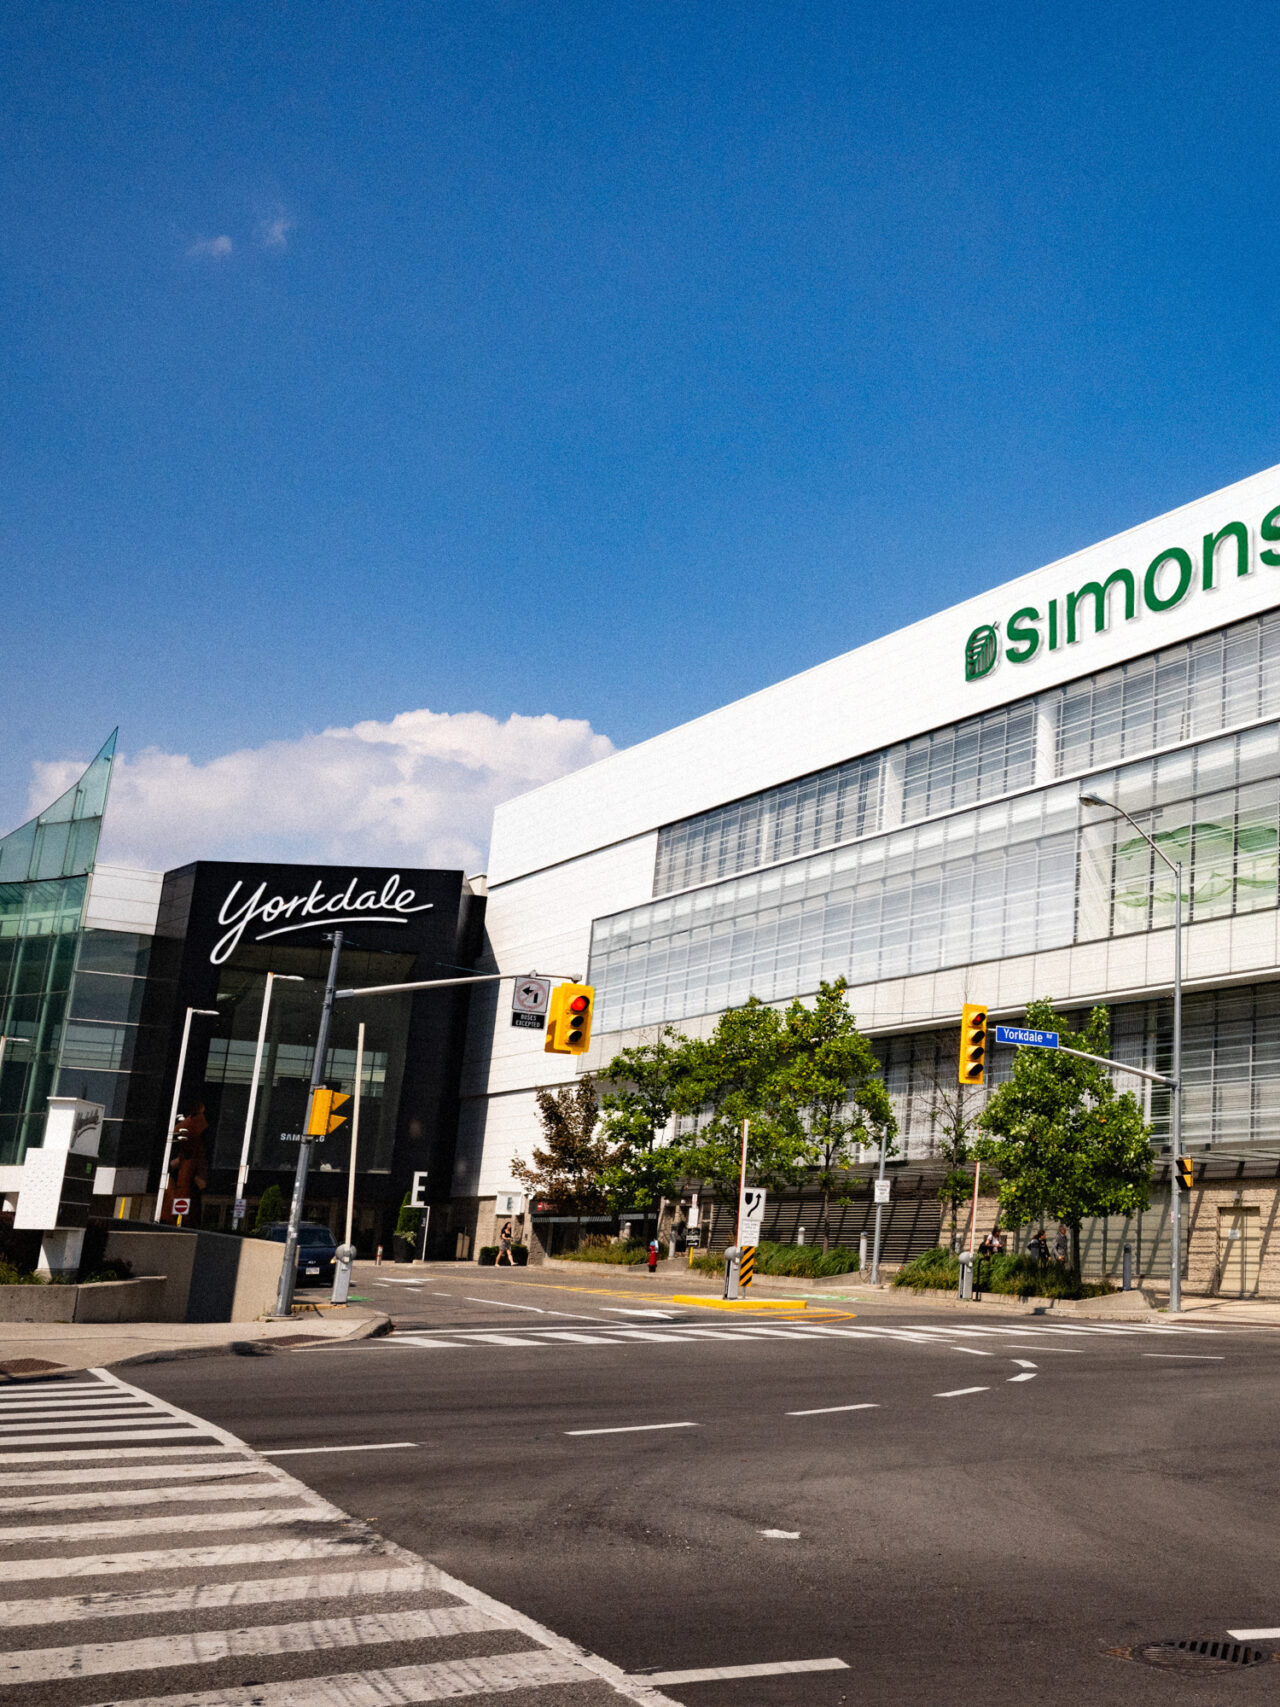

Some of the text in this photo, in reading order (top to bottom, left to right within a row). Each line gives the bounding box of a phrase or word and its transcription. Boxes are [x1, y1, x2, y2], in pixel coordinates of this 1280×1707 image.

[210, 874, 434, 965] Yorkdale
[515, 1020, 541, 1028] EXCEPTED
[1003, 1028, 1043, 1043] Yorkdale
[280, 1132, 325, 1143] SAMG
[410, 1171, 428, 1206] E
